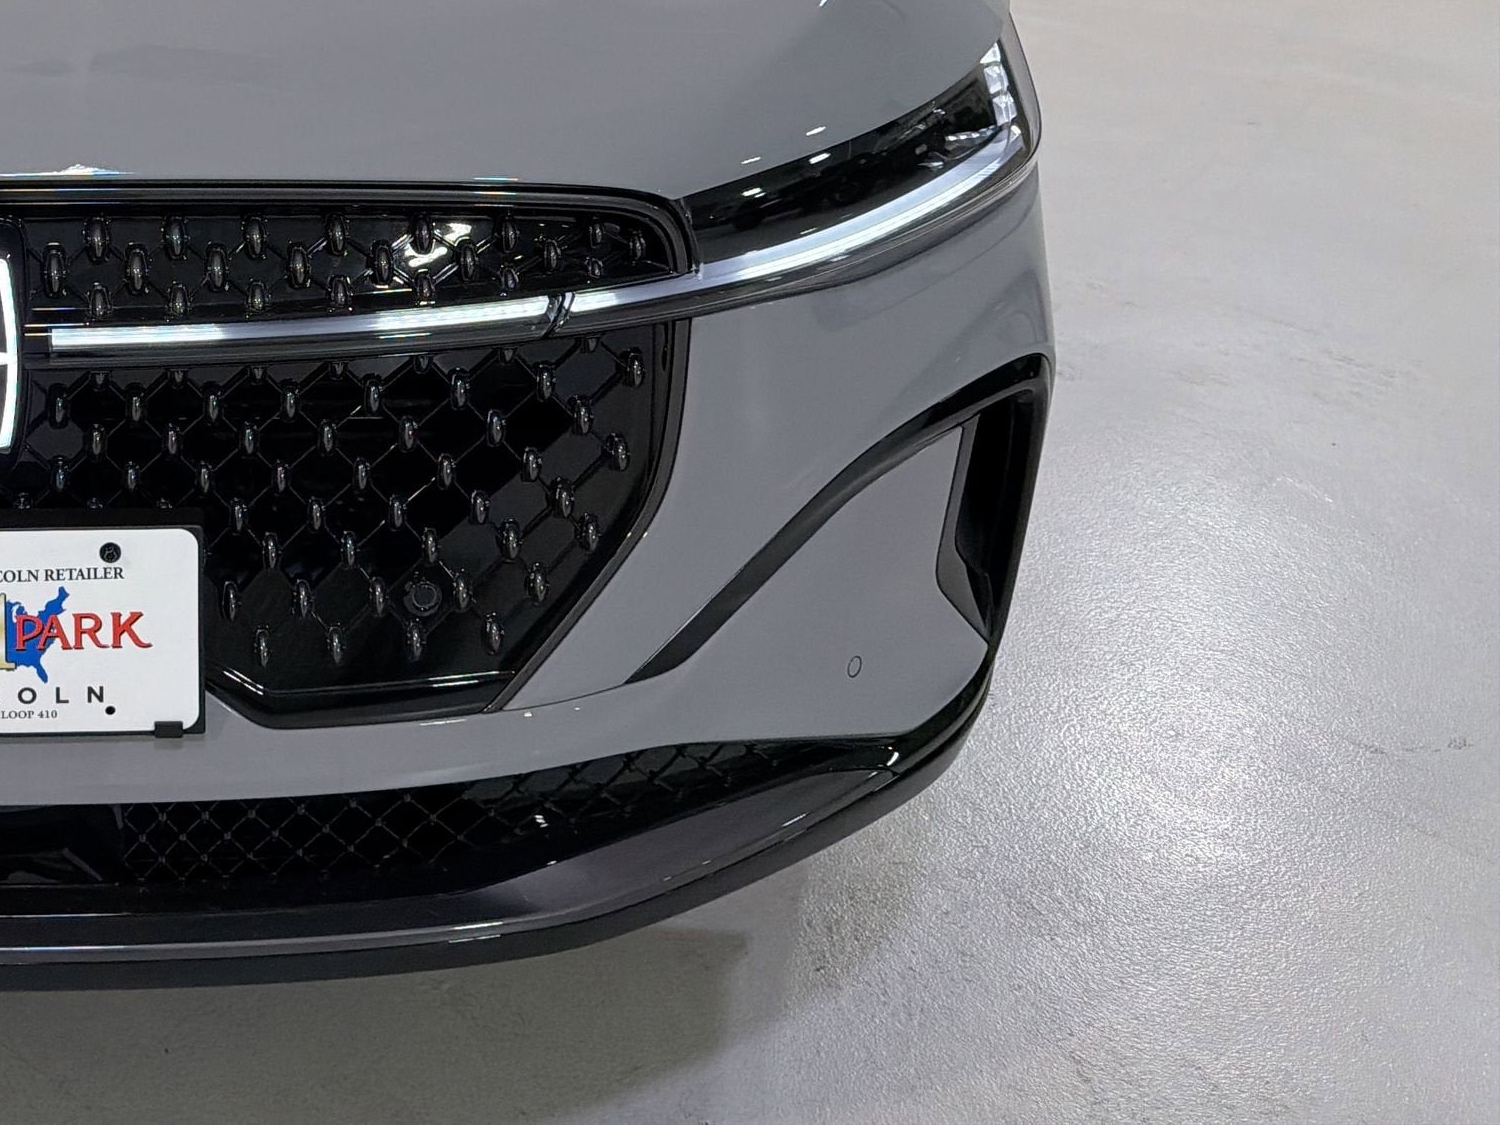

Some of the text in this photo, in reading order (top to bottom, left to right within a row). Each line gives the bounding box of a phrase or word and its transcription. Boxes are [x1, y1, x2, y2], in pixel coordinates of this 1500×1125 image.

[43, 566, 125, 582] RETAILER
[13, 610, 152, 651] PARK
[0, 709, 36, 720] LOOP
[37, 709, 59, 719] 410
